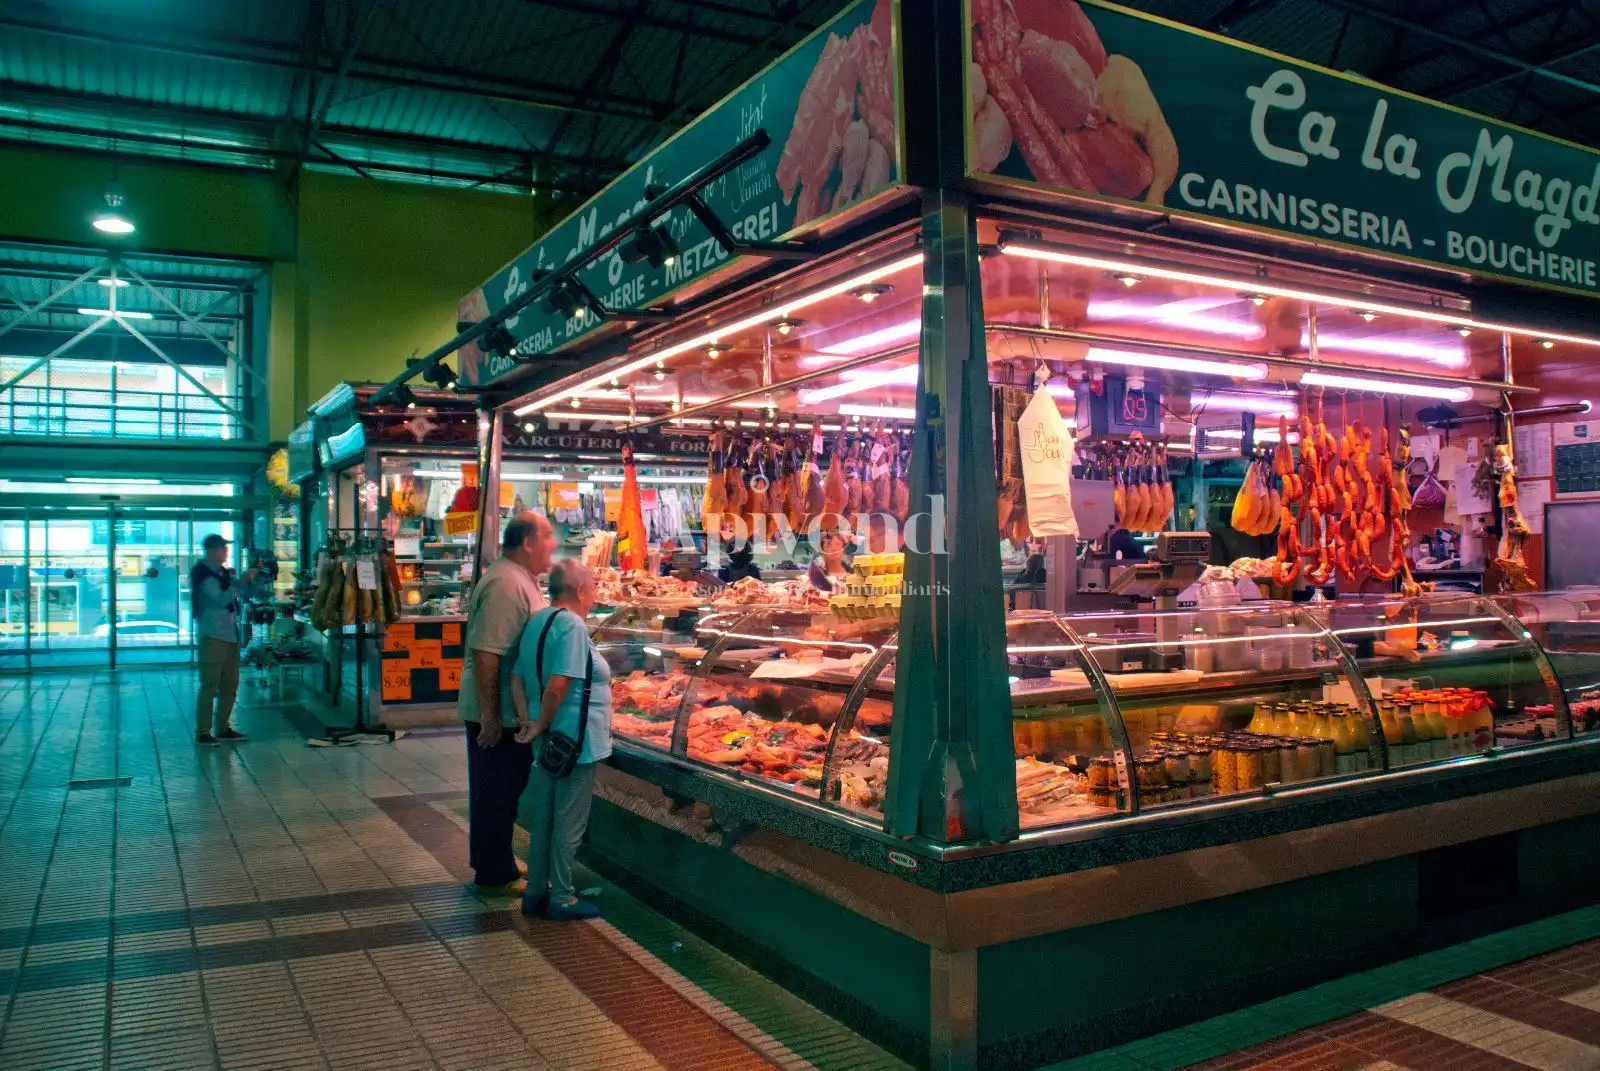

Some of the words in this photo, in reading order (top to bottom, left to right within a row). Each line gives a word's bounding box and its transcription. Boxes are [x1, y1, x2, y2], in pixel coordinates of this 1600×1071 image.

[1246, 69, 1341, 167] Ca
[1362, 99, 1421, 179] la
[1179, 172, 1413, 250] CARNISSERIA
[1446, 230, 1597, 287] BOUCHERIE
